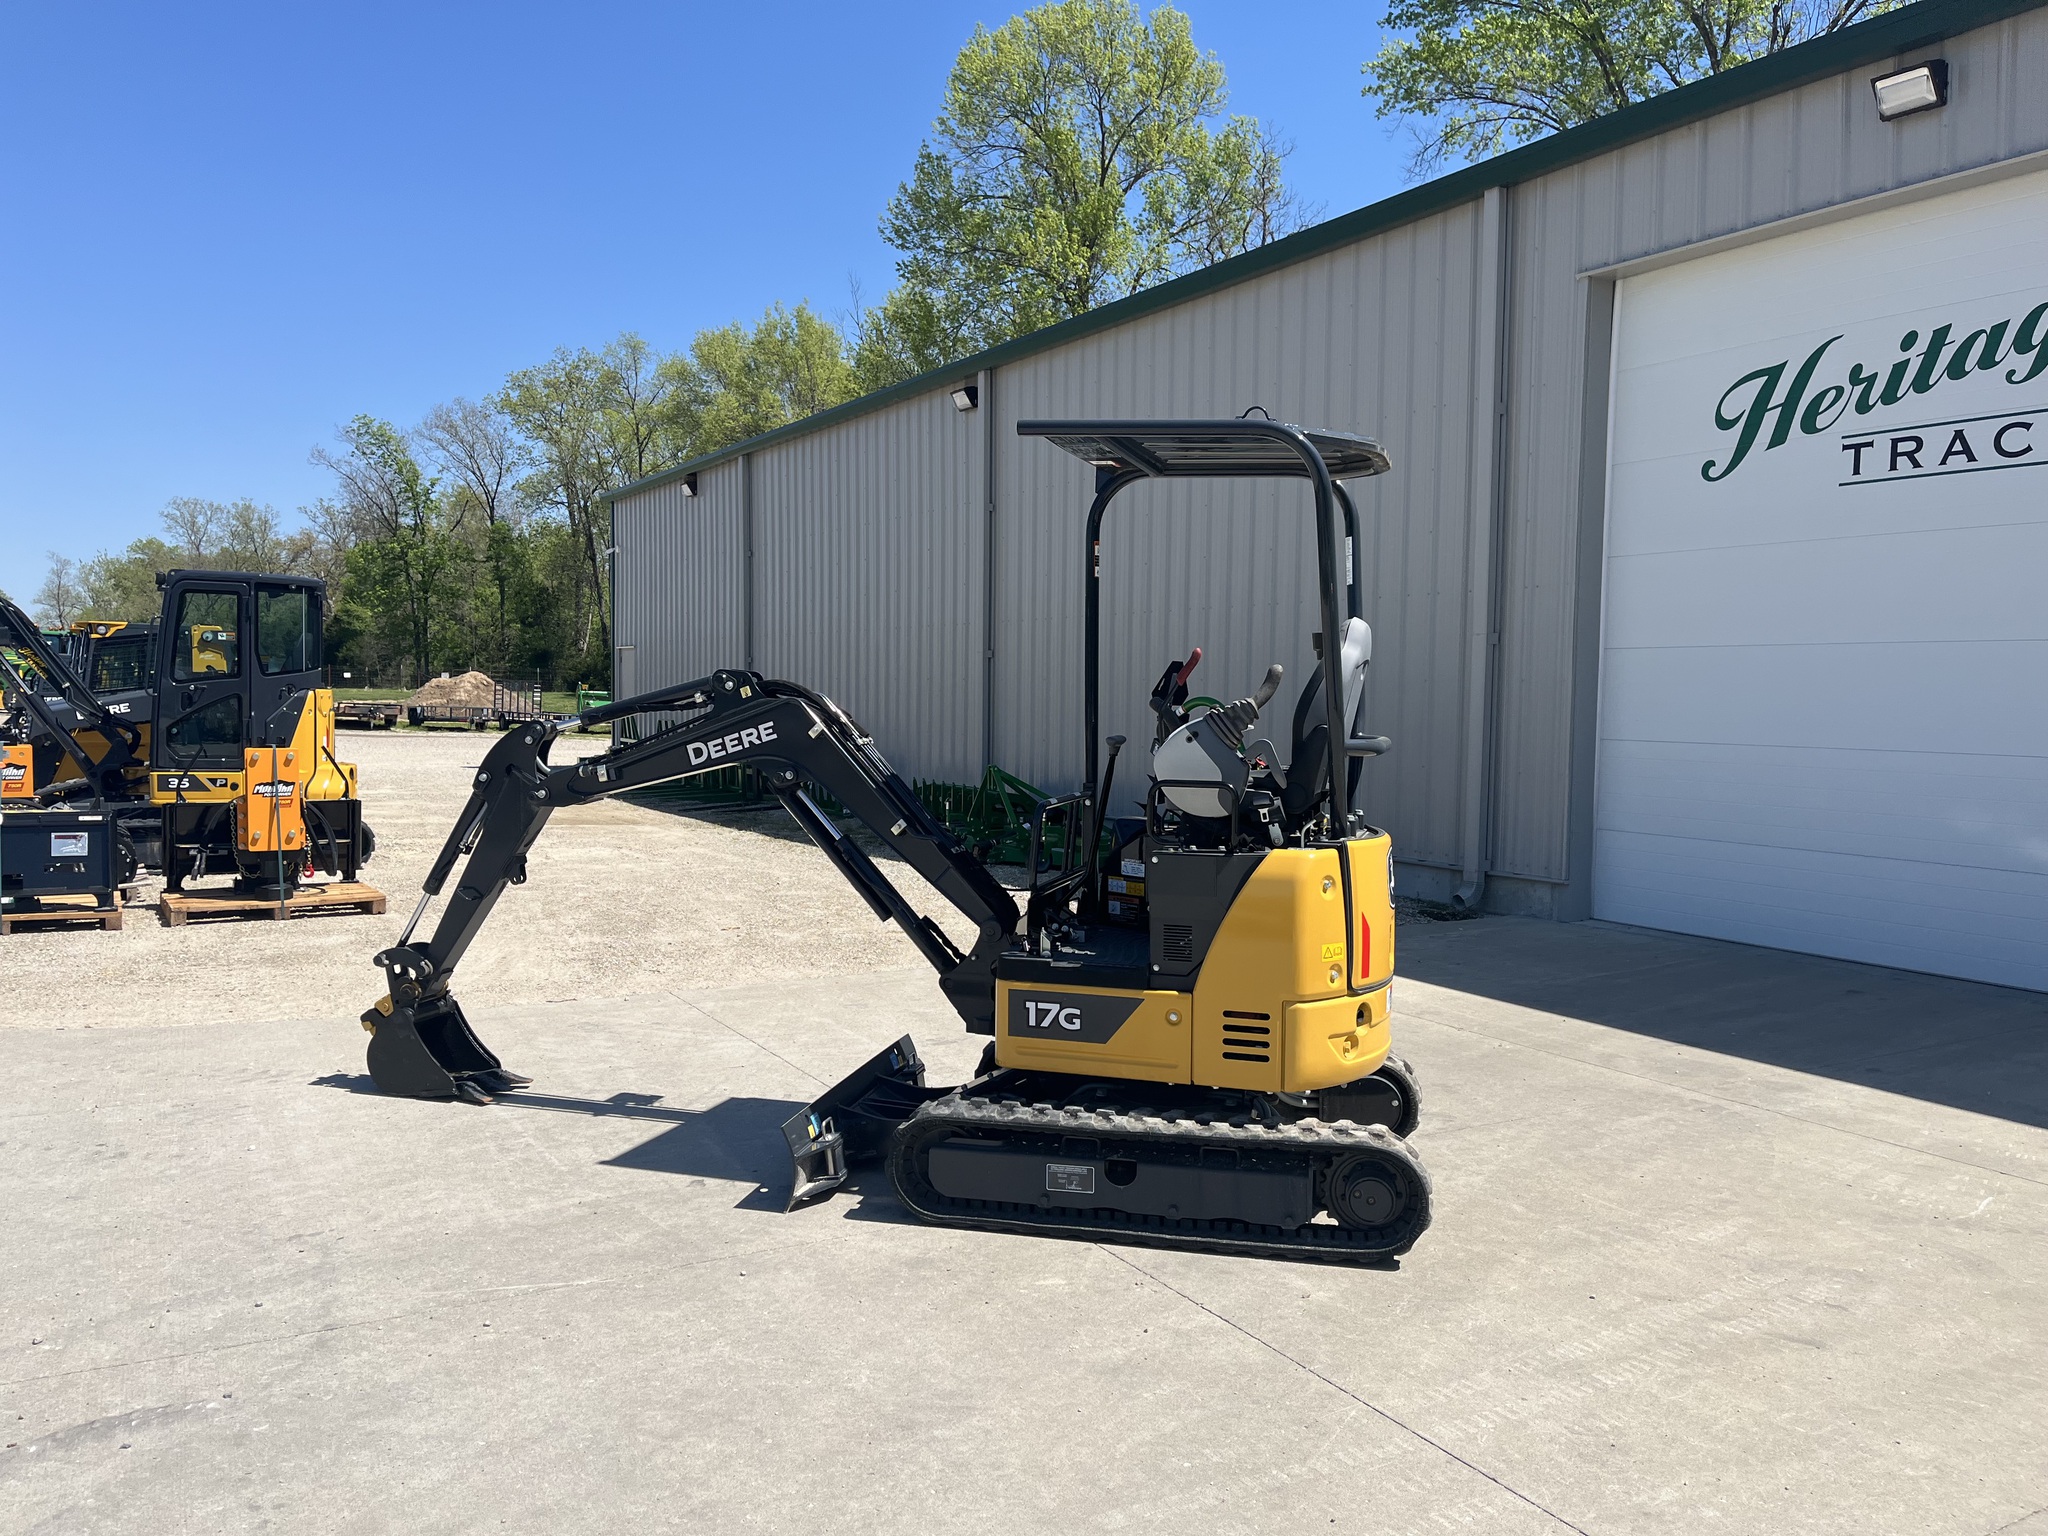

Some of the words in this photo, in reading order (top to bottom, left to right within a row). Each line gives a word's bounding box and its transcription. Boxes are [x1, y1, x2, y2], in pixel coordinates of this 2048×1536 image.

[1841, 421, 2034, 477] TRAC
[686, 720, 778, 766] DEERE
[1025, 1001, 1081, 1031] 17G
